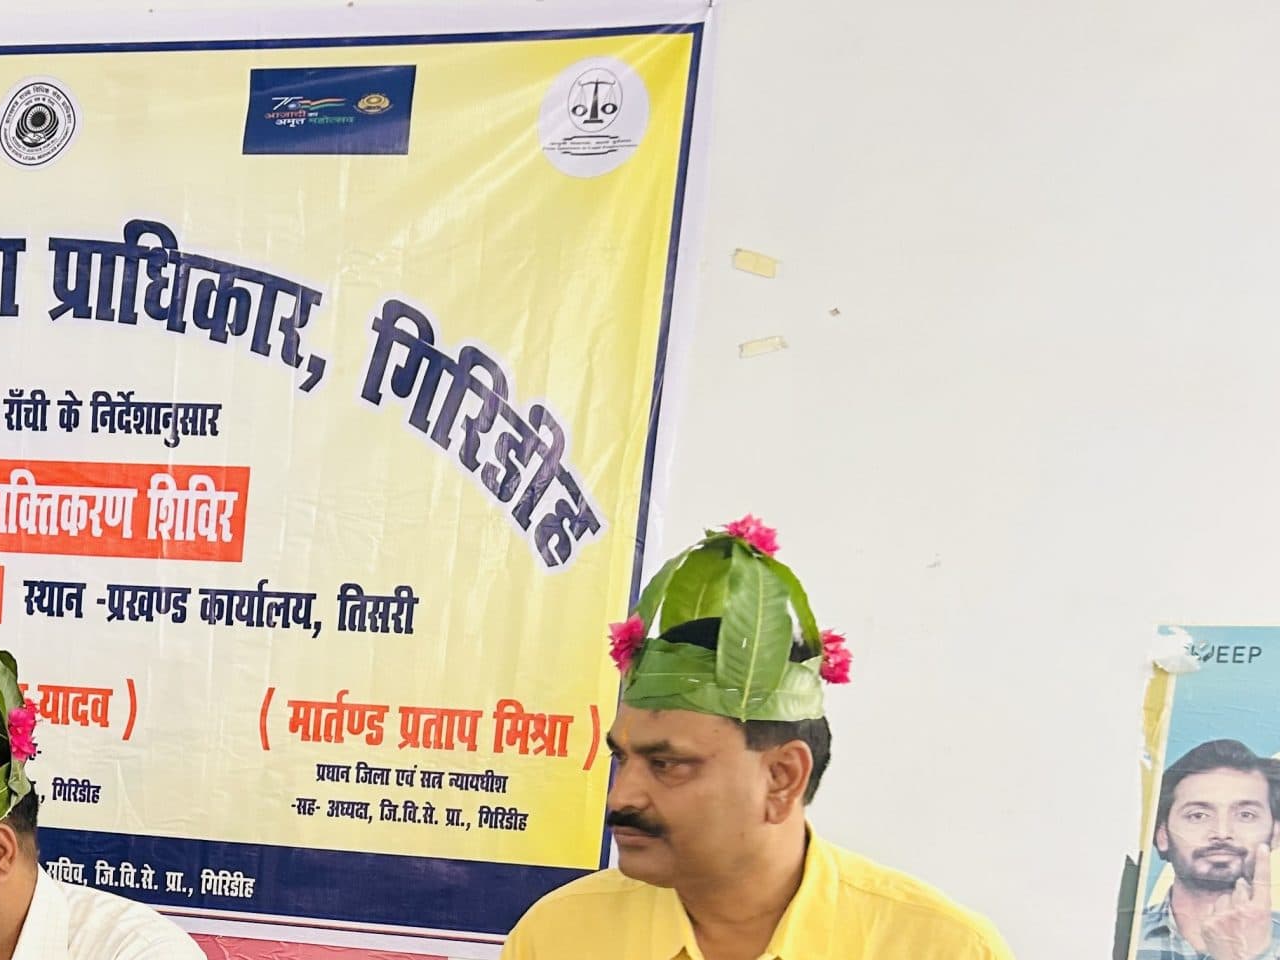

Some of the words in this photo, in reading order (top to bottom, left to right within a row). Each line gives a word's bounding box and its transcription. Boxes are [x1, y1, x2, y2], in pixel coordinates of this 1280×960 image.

[49, 219, 327, 392] प्राधिकार,
[361, 299, 601, 568] गिरिडीह
[58, 390, 83, 433] के
[90, 391, 222, 448] निर्देशानुसार
[147, 471, 238, 542] शिविर
[23, 579, 87, 619] स्थान
[198, 578, 322, 639] कार्यालय,
[337, 582, 419, 635] तिसरी
[37, 684, 113, 728] यादव
[286, 689, 389, 745] मार्तण्ड
[398, 705, 484, 752] प्रताप
[493, 698, 574, 757] मिश्रा
[52, 777, 101, 804] गिरिडीह
[316, 763, 350, 783] प्रधान
[356, 761, 390, 786] जिला
[396, 764, 418, 787] एवं
[327, 799, 372, 824] अध्यक्ष,
[478, 805, 529, 831] गिरिडीह
[46, 857, 87, 887] सचिव,
[200, 869, 255, 898] गिरिडीह
